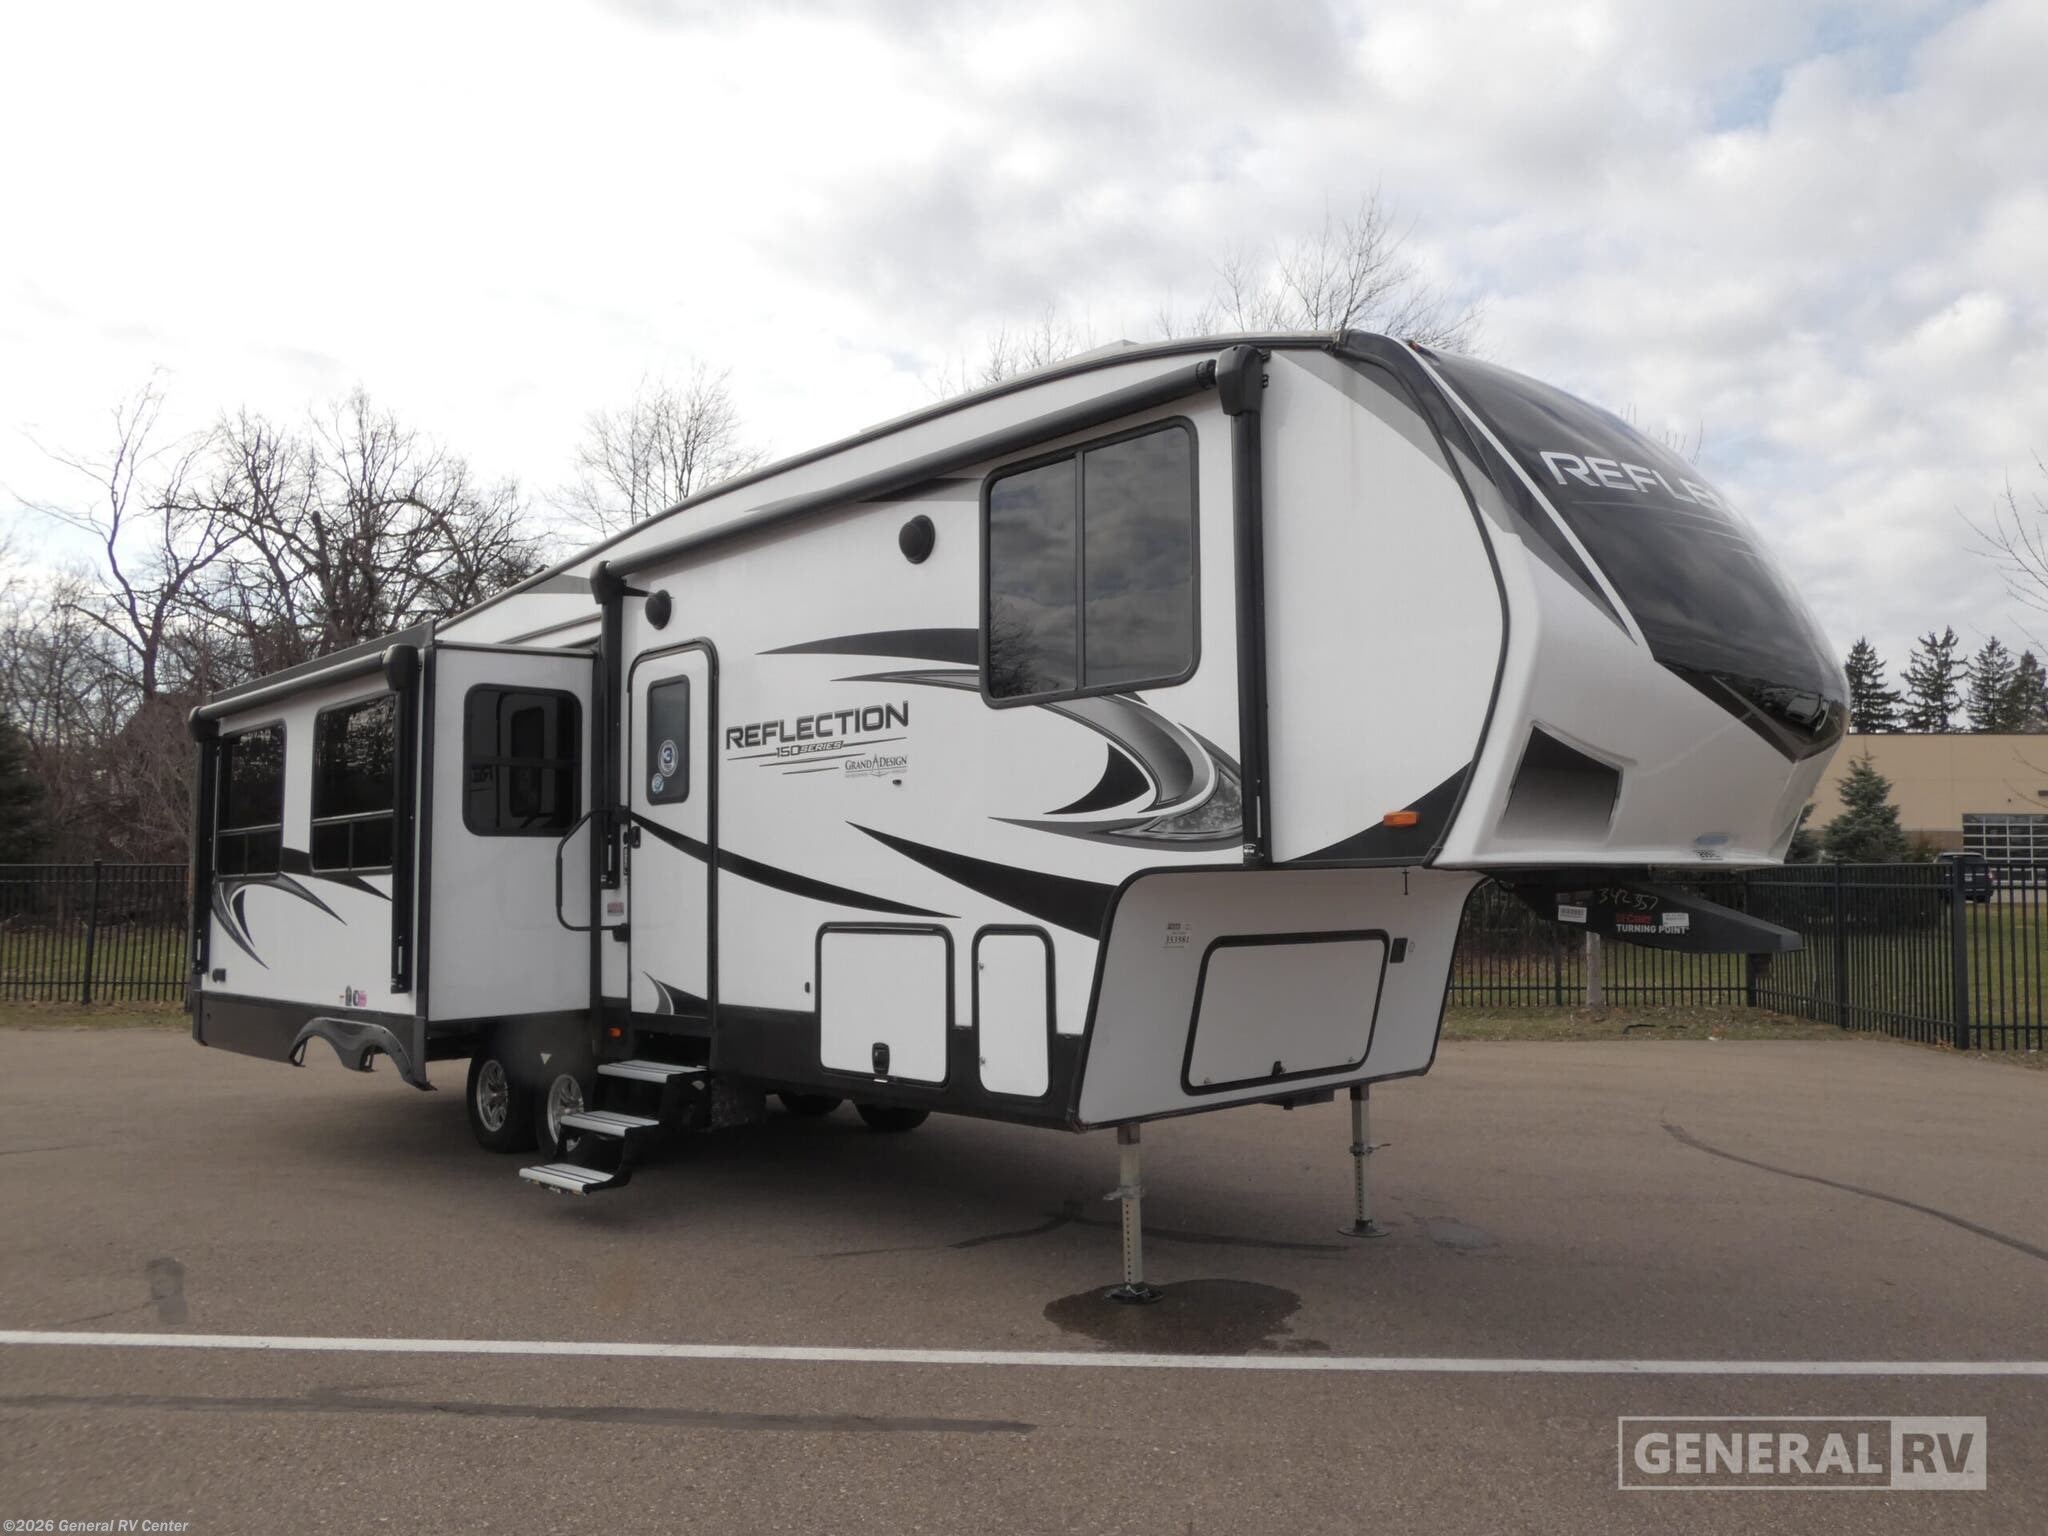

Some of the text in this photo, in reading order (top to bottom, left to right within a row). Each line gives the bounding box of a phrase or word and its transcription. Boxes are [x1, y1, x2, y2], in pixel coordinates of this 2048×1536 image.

[726, 700, 909, 750] REFLECTION
[845, 755, 908, 771] GRAND DESIGN
[1616, 924, 1686, 935] TURNING POINT
